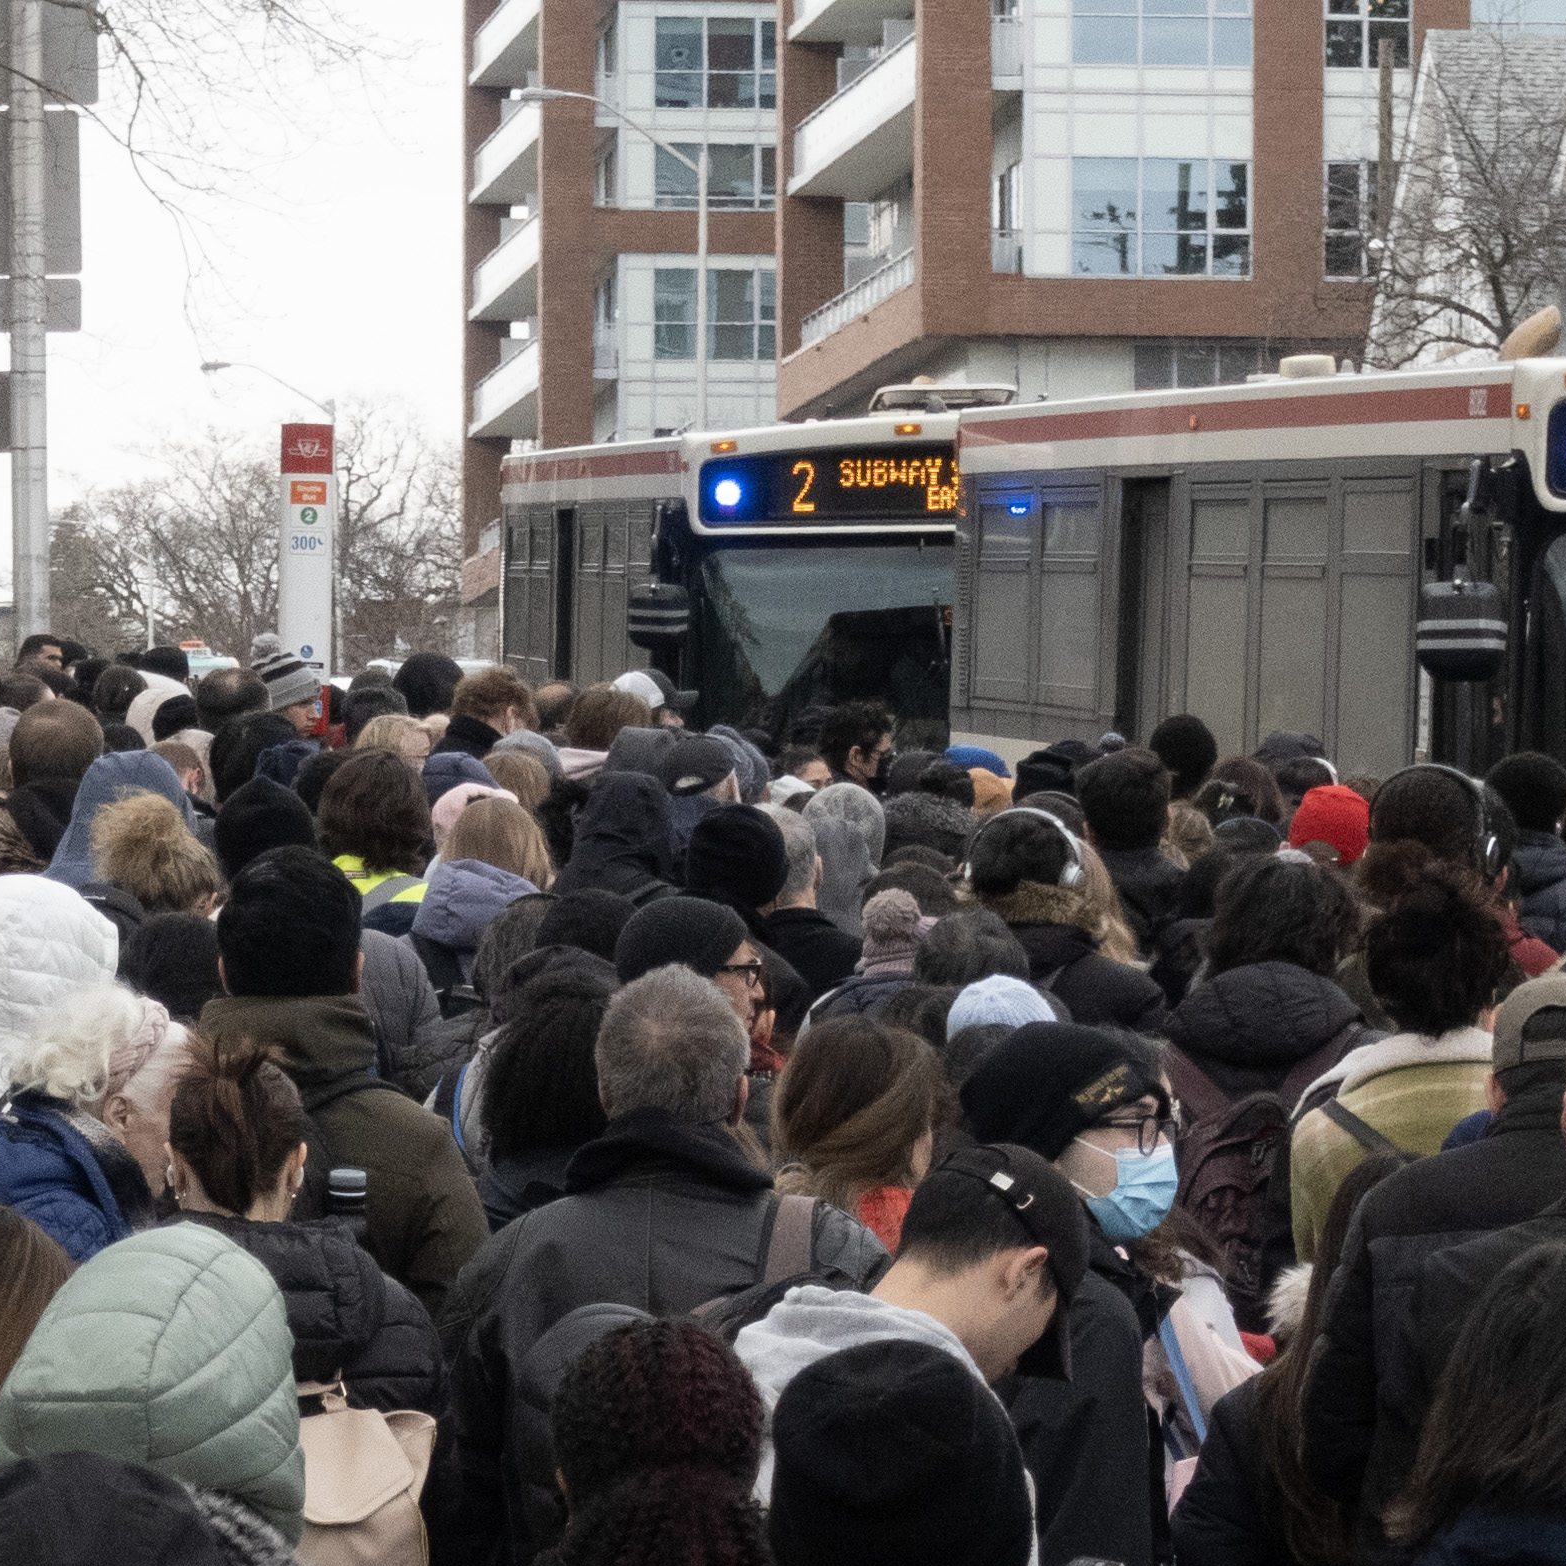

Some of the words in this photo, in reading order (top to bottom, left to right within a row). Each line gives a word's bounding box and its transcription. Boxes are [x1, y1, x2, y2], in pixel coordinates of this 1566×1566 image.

[792, 461, 816, 513] 2
[840, 458, 942, 487] SUBWAY
[304, 510, 314, 522] 2
[292, 536, 316, 550] 300
